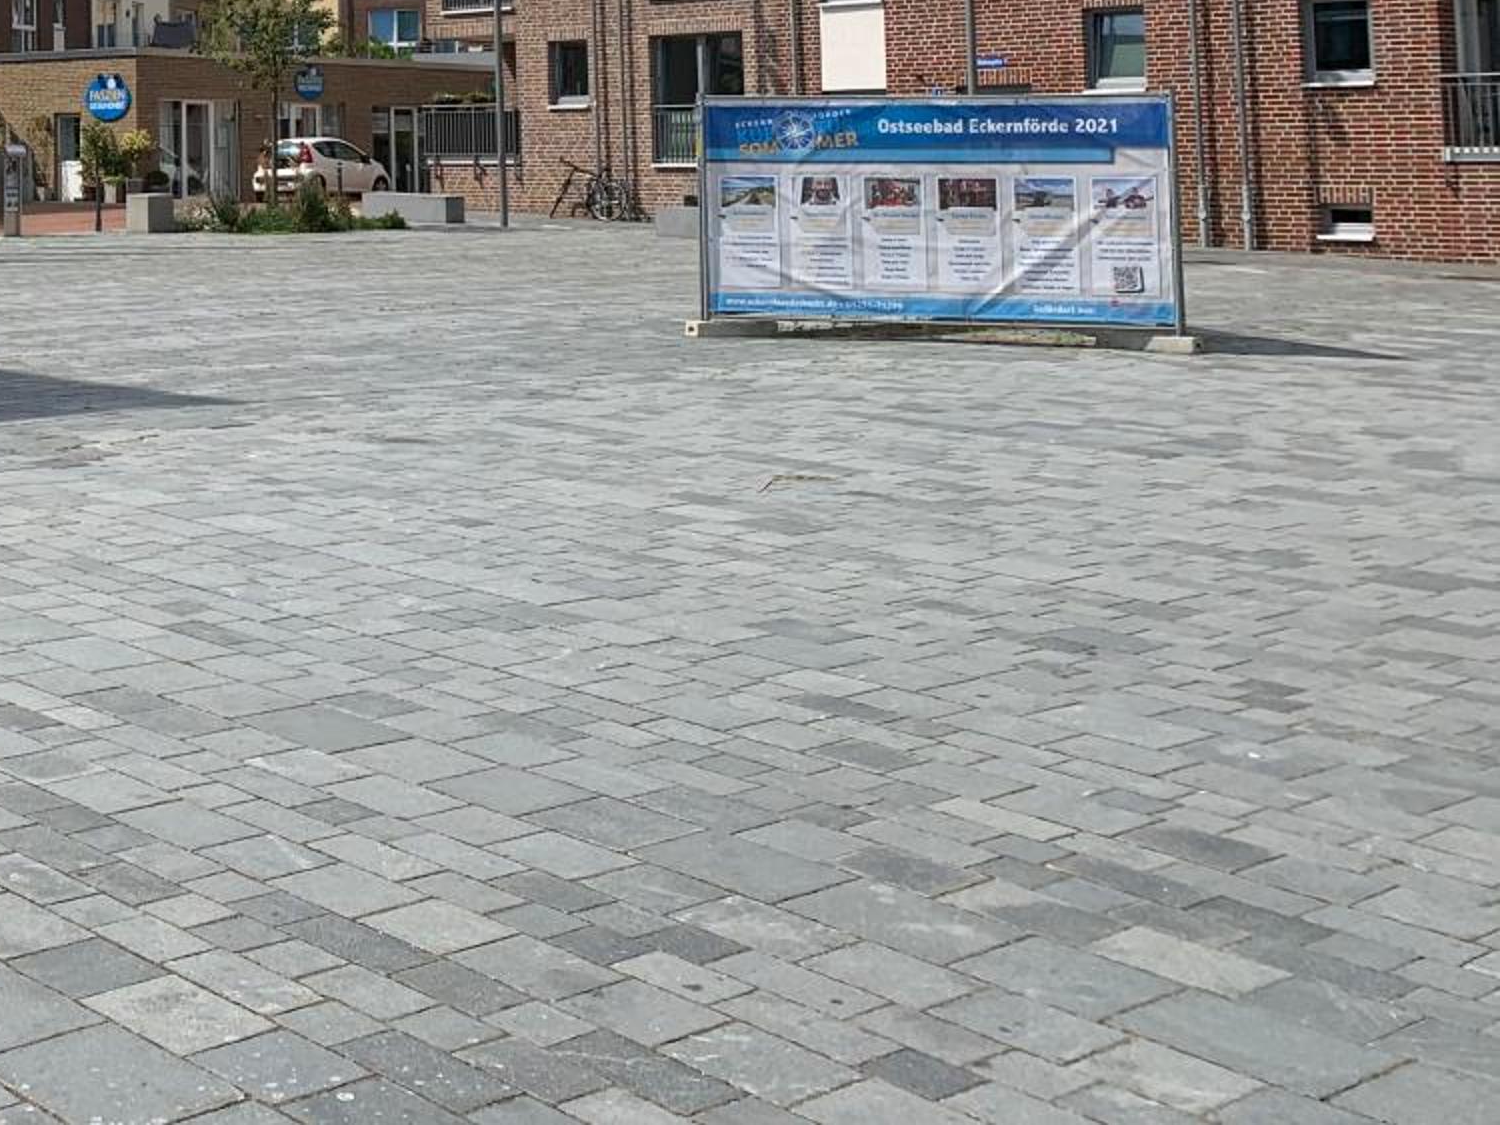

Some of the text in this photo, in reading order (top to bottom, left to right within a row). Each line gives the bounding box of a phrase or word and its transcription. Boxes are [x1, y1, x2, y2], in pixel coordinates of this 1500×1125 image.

[877, 118, 1118, 134] Ostseebad Eckernförde 2021
